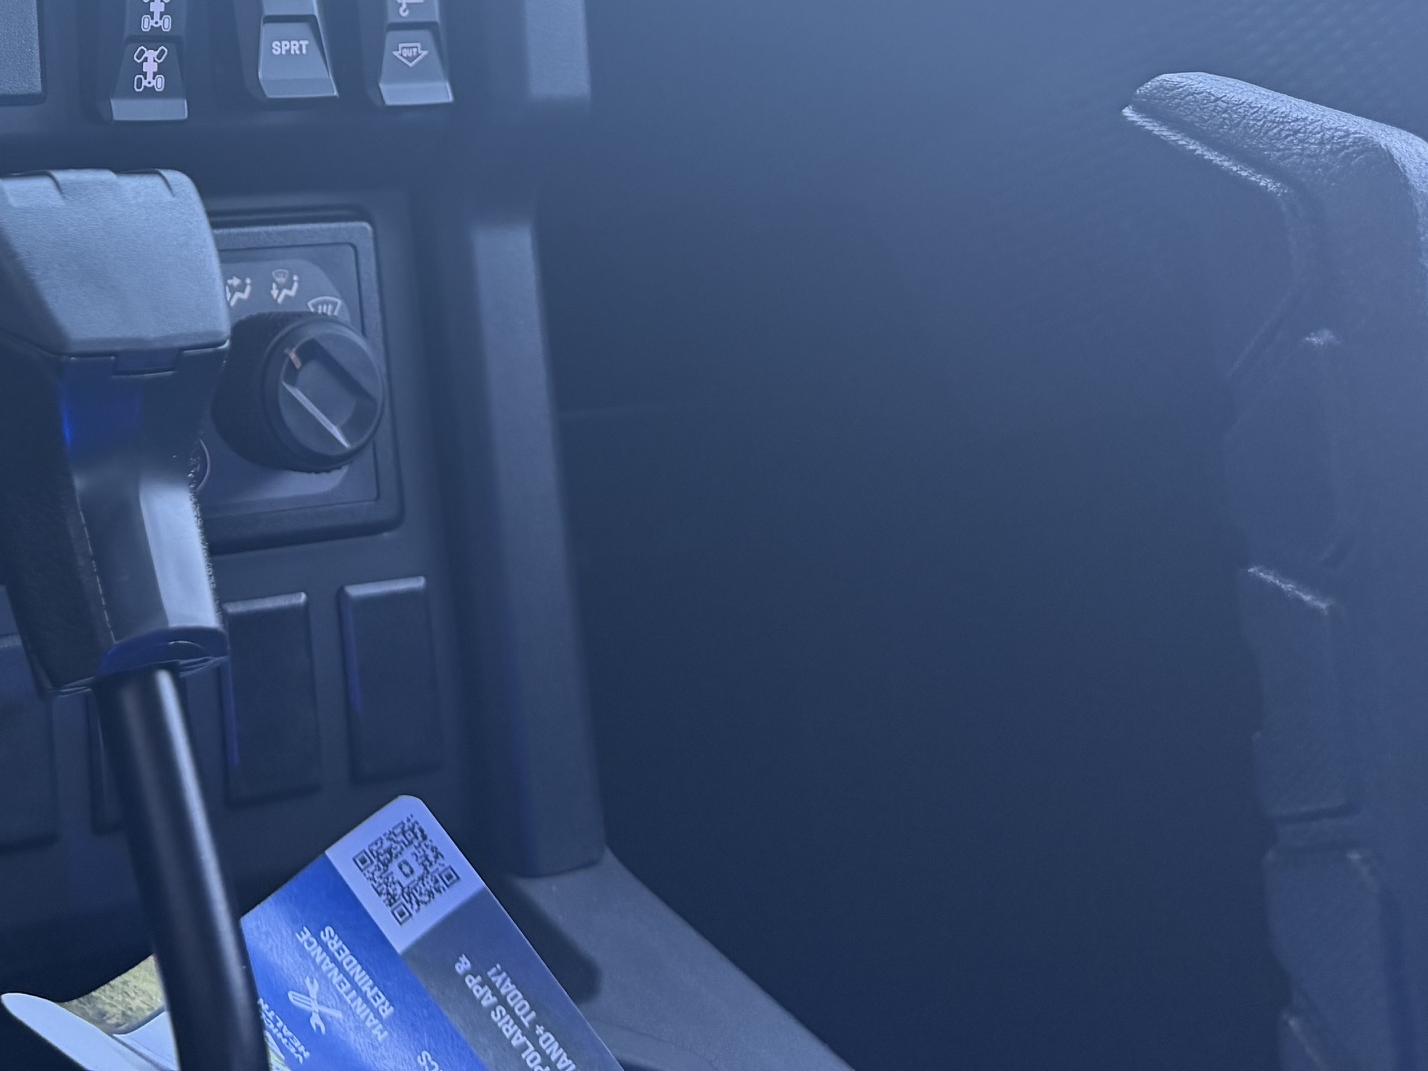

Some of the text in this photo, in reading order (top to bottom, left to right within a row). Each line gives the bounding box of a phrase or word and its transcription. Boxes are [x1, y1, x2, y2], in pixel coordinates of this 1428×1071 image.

[271, 40, 309, 56] SPRT
[401, 47, 418, 58] OUT
[319, 924, 395, 1020] REMINDERS
[454, 953, 472, 976] &
[295, 925, 388, 1042] MAINTENANCE
[464, 973, 498, 1008] APP
[486, 963, 538, 1029] TODAY!
